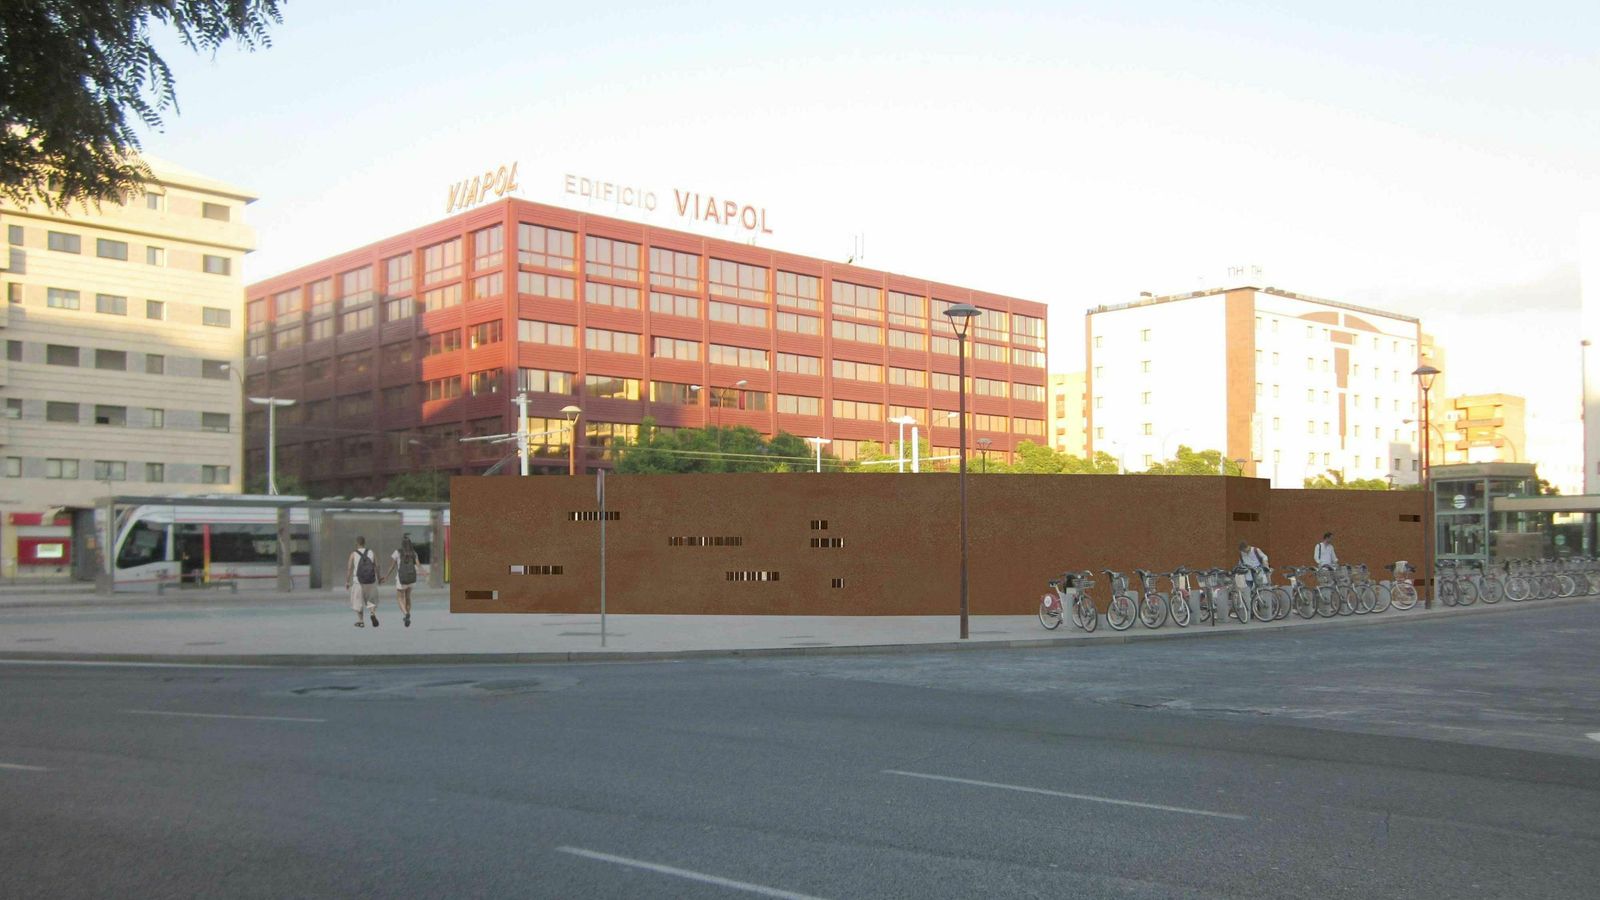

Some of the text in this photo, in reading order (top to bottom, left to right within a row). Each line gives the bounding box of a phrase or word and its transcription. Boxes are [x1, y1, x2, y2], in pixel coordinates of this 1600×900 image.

[447, 161, 518, 213] VIAPOL
[565, 174, 773, 233] EDIFICIO VIAPOL
